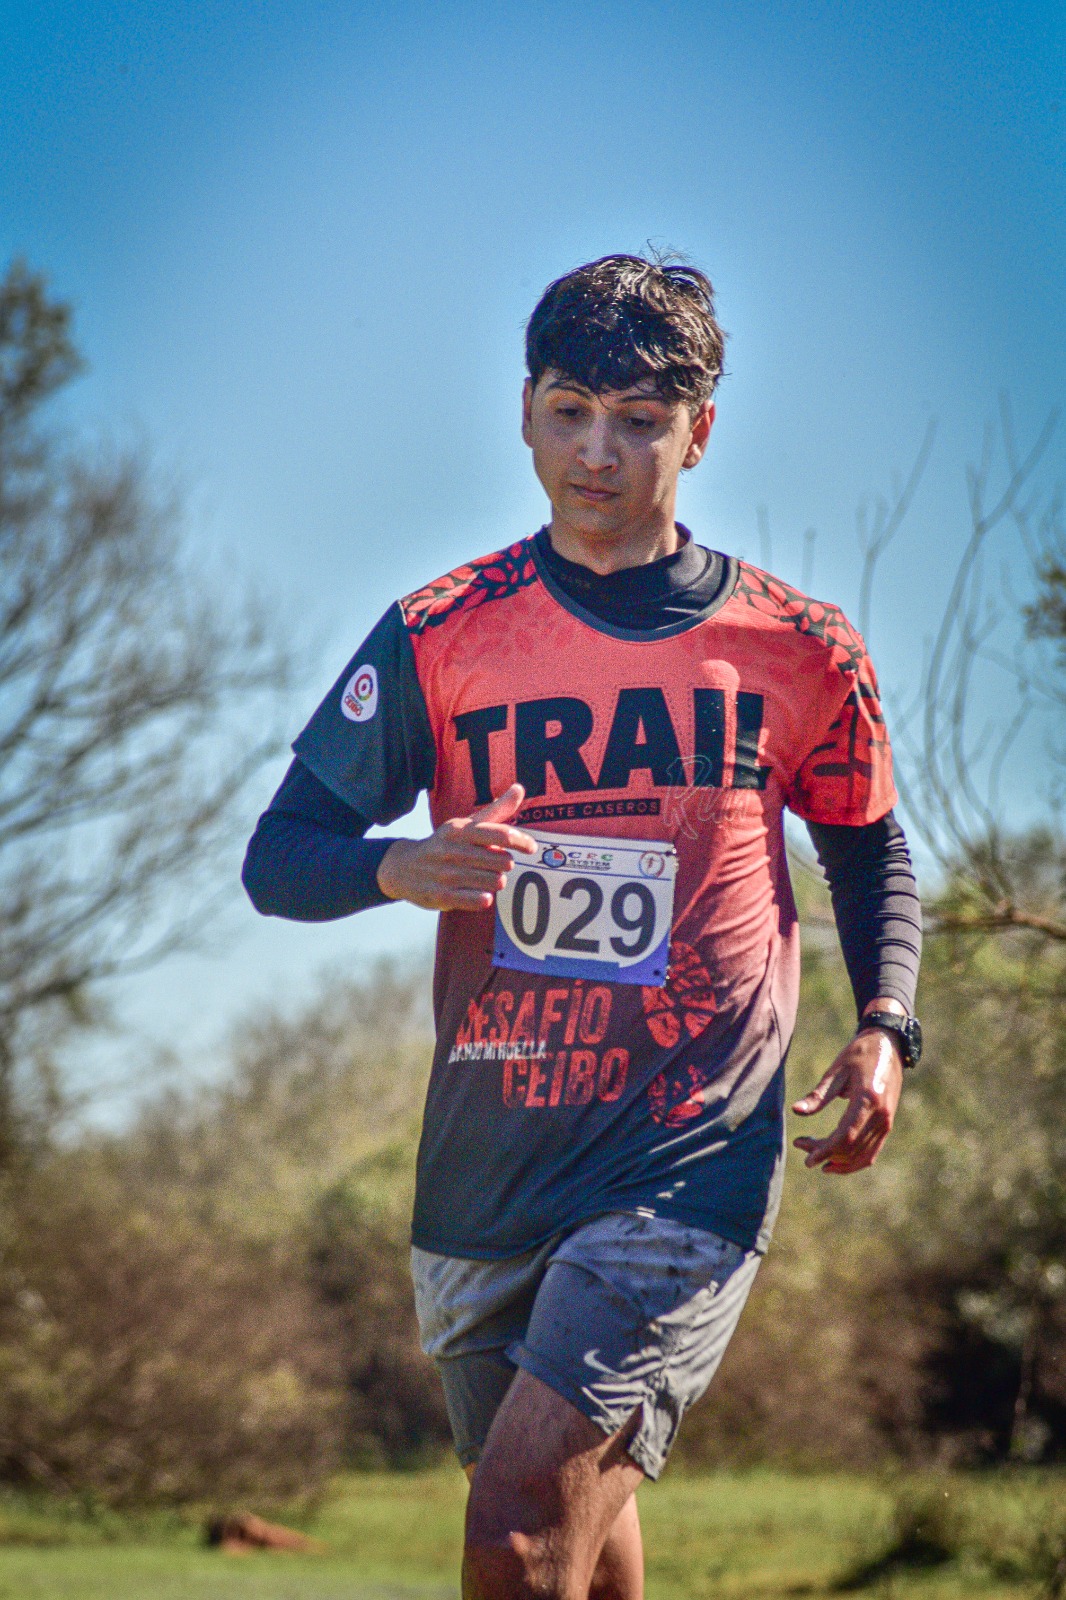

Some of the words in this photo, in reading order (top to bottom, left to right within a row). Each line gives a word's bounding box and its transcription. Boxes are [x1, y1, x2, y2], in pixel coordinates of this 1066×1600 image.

[451, 687, 773, 807] TRAIL
[518, 806, 576, 822] MONTE
[582, 801, 658, 816] CASEROS
[511, 871, 657, 958] 029
[502, 1047, 630, 1108] CEIBO
